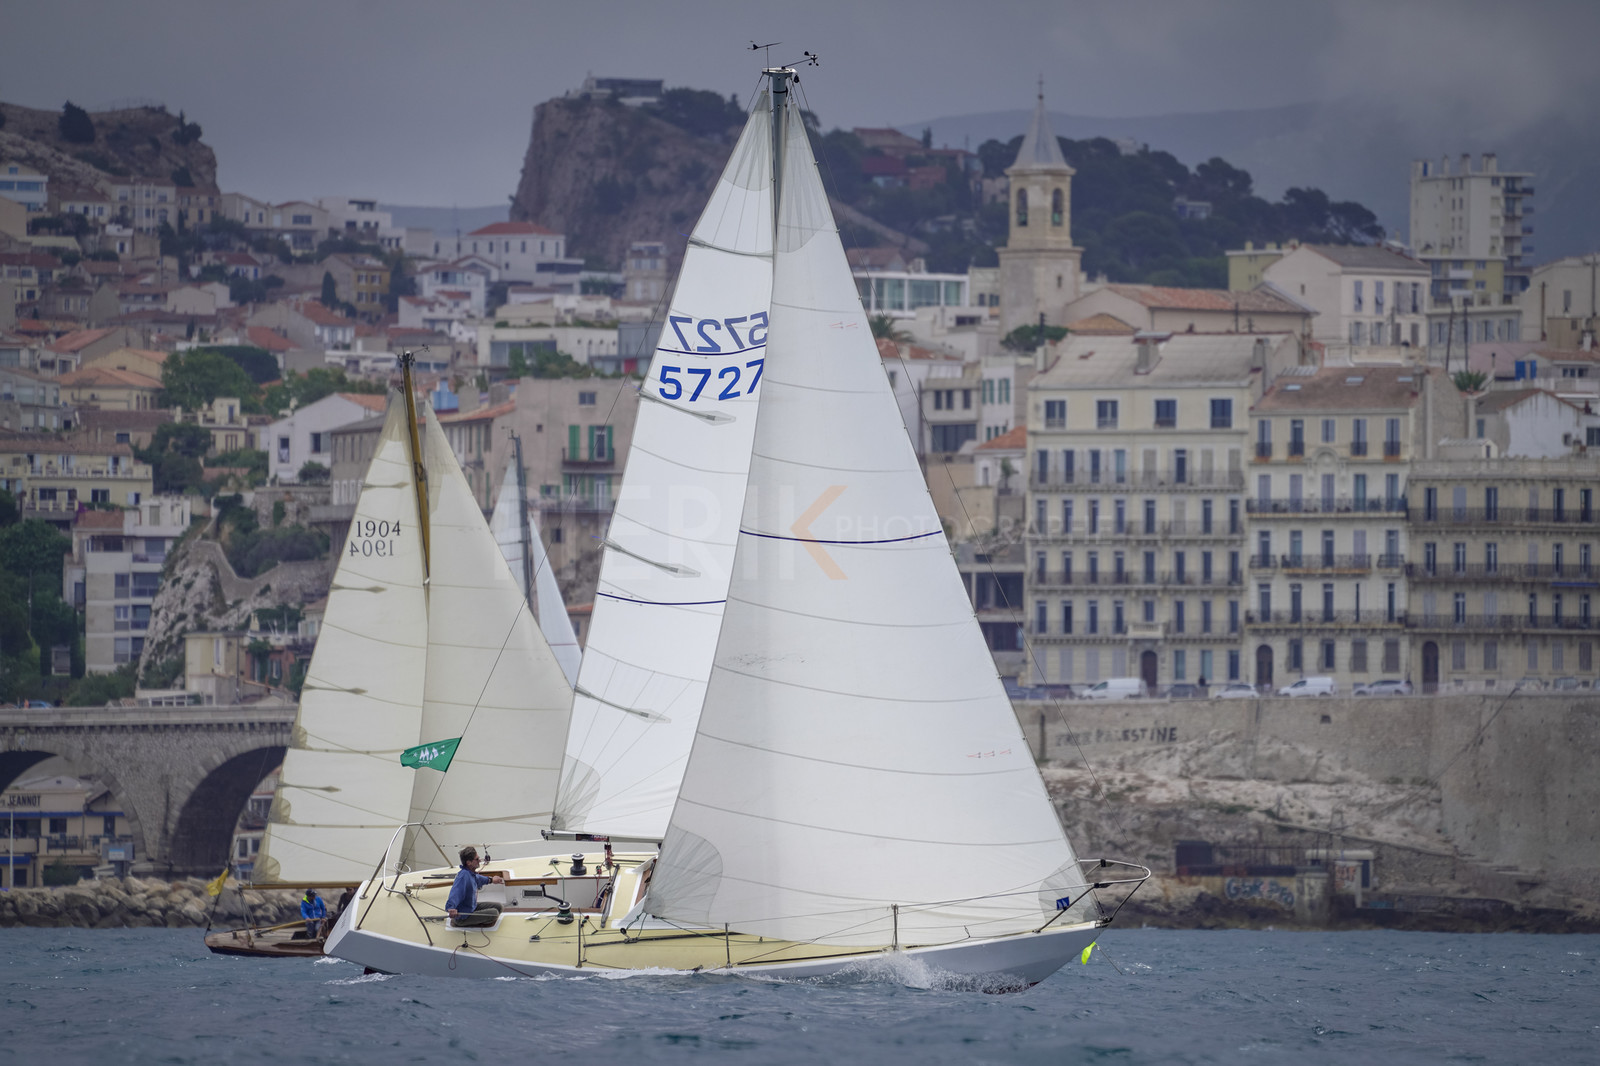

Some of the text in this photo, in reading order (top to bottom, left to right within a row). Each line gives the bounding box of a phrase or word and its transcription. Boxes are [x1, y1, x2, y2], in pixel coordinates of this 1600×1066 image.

[659, 358, 765, 402] 5727
[356, 520, 401, 538] 1904
[7, 793, 41, 808] JEANNOT
